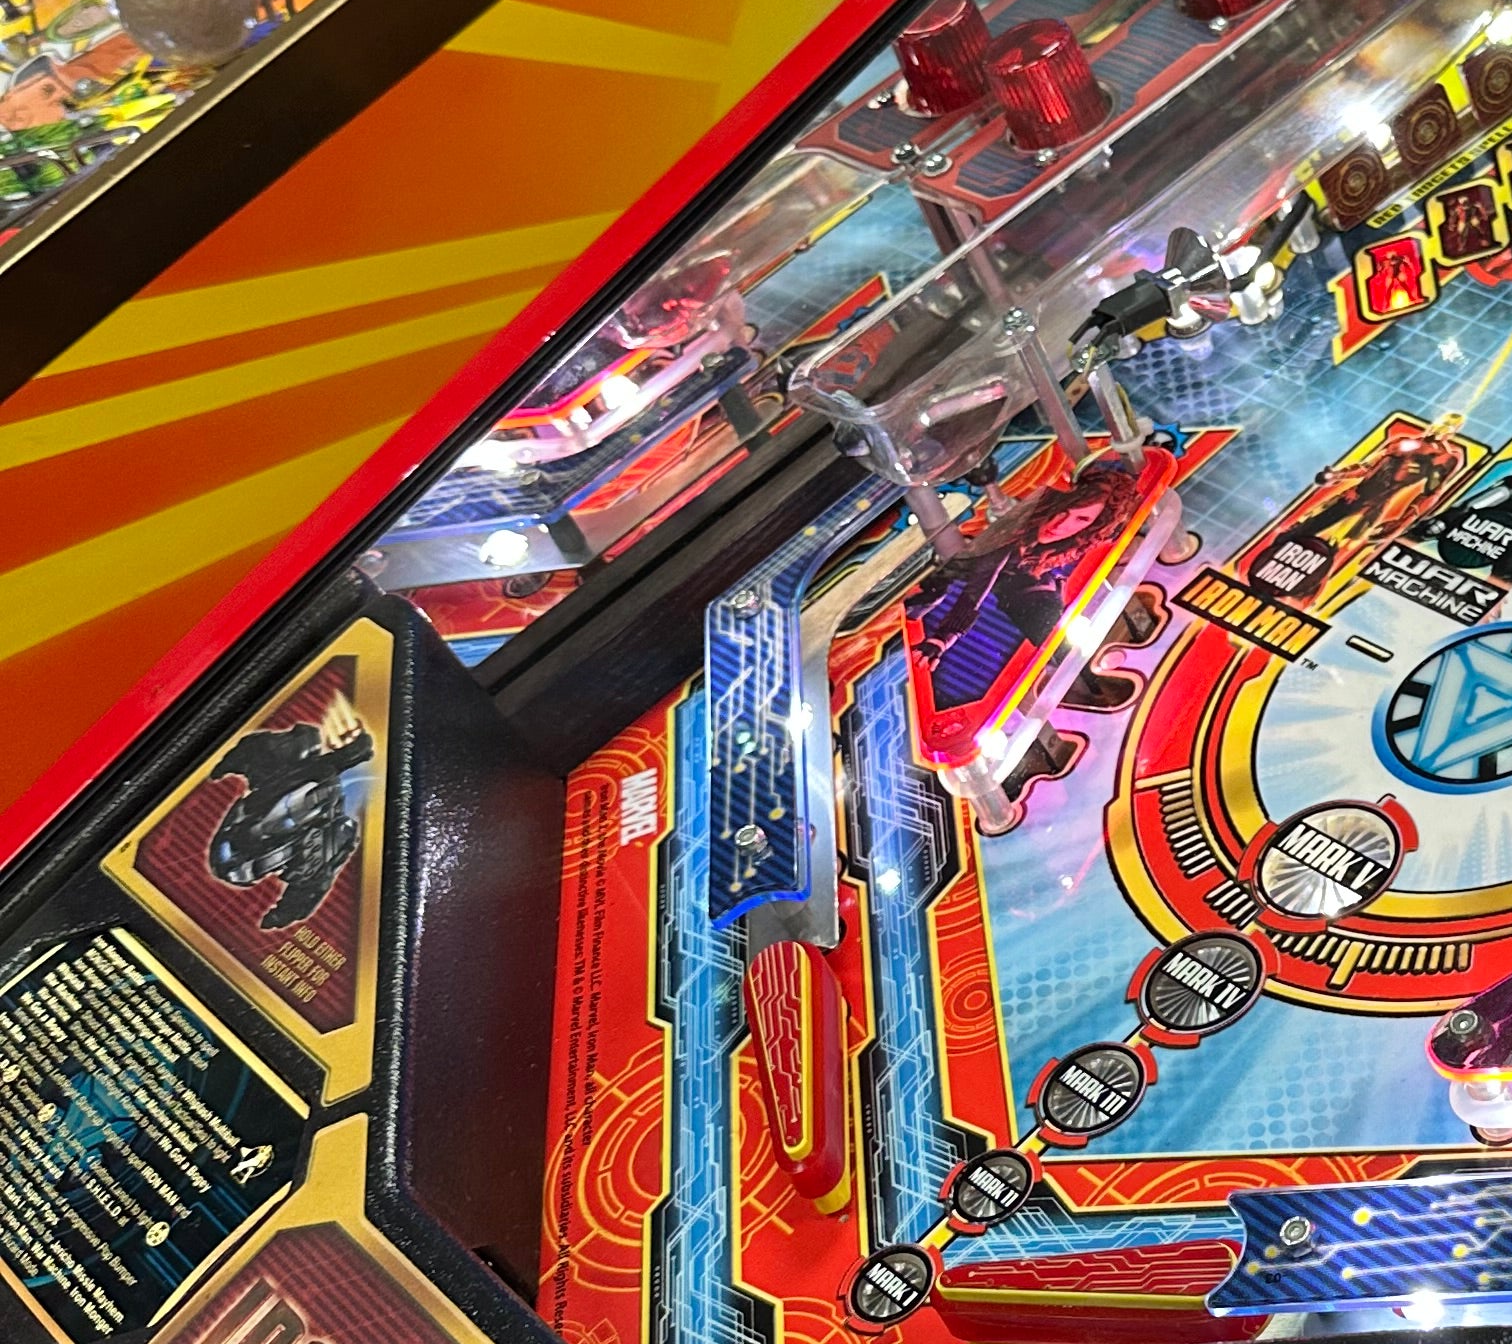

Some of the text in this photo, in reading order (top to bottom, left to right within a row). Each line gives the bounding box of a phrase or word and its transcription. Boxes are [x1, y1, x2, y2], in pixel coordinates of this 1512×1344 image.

[1272, 542, 1329, 576] IRON
[1448, 528, 1508, 561] MACHINE
[1253, 561, 1308, 594] MAN
[1364, 562, 1485, 625] MACHINE
[1382, 545, 1500, 608] WAR
[1182, 574, 1322, 656] IRON MAN
[619, 766, 658, 846] MARVEL
[1278, 826, 1384, 891] MARK V
[259, 952, 300, 989] INSTANT
[276, 939, 331, 987] FLIPPER FOR
[292, 923, 348, 971] HOLD EITHER
[1165, 953, 1248, 1010] MARK IV
[569, 995, 583, 1030] Marvel
[563, 1031, 580, 1111] Entertainment,
[1060, 1064, 1128, 1116] MARK III
[139, 1162, 165, 1190] IRON
[157, 1181, 181, 1208] MAN
[158, 1134, 176, 1155] We
[167, 1146, 187, 1168] Got
[184, 1165, 211, 1196] Bogey
[972, 1166, 1019, 1208] MARK II
[557, 1171, 573, 1240] subsidiaries.
[48, 1238, 77, 1271] Jericho
[108, 1254, 138, 1289] Bumper
[68, 1285, 88, 1309] Iron
[553, 1261, 568, 1299] Rights
[867, 1262, 917, 1307] MARK I
